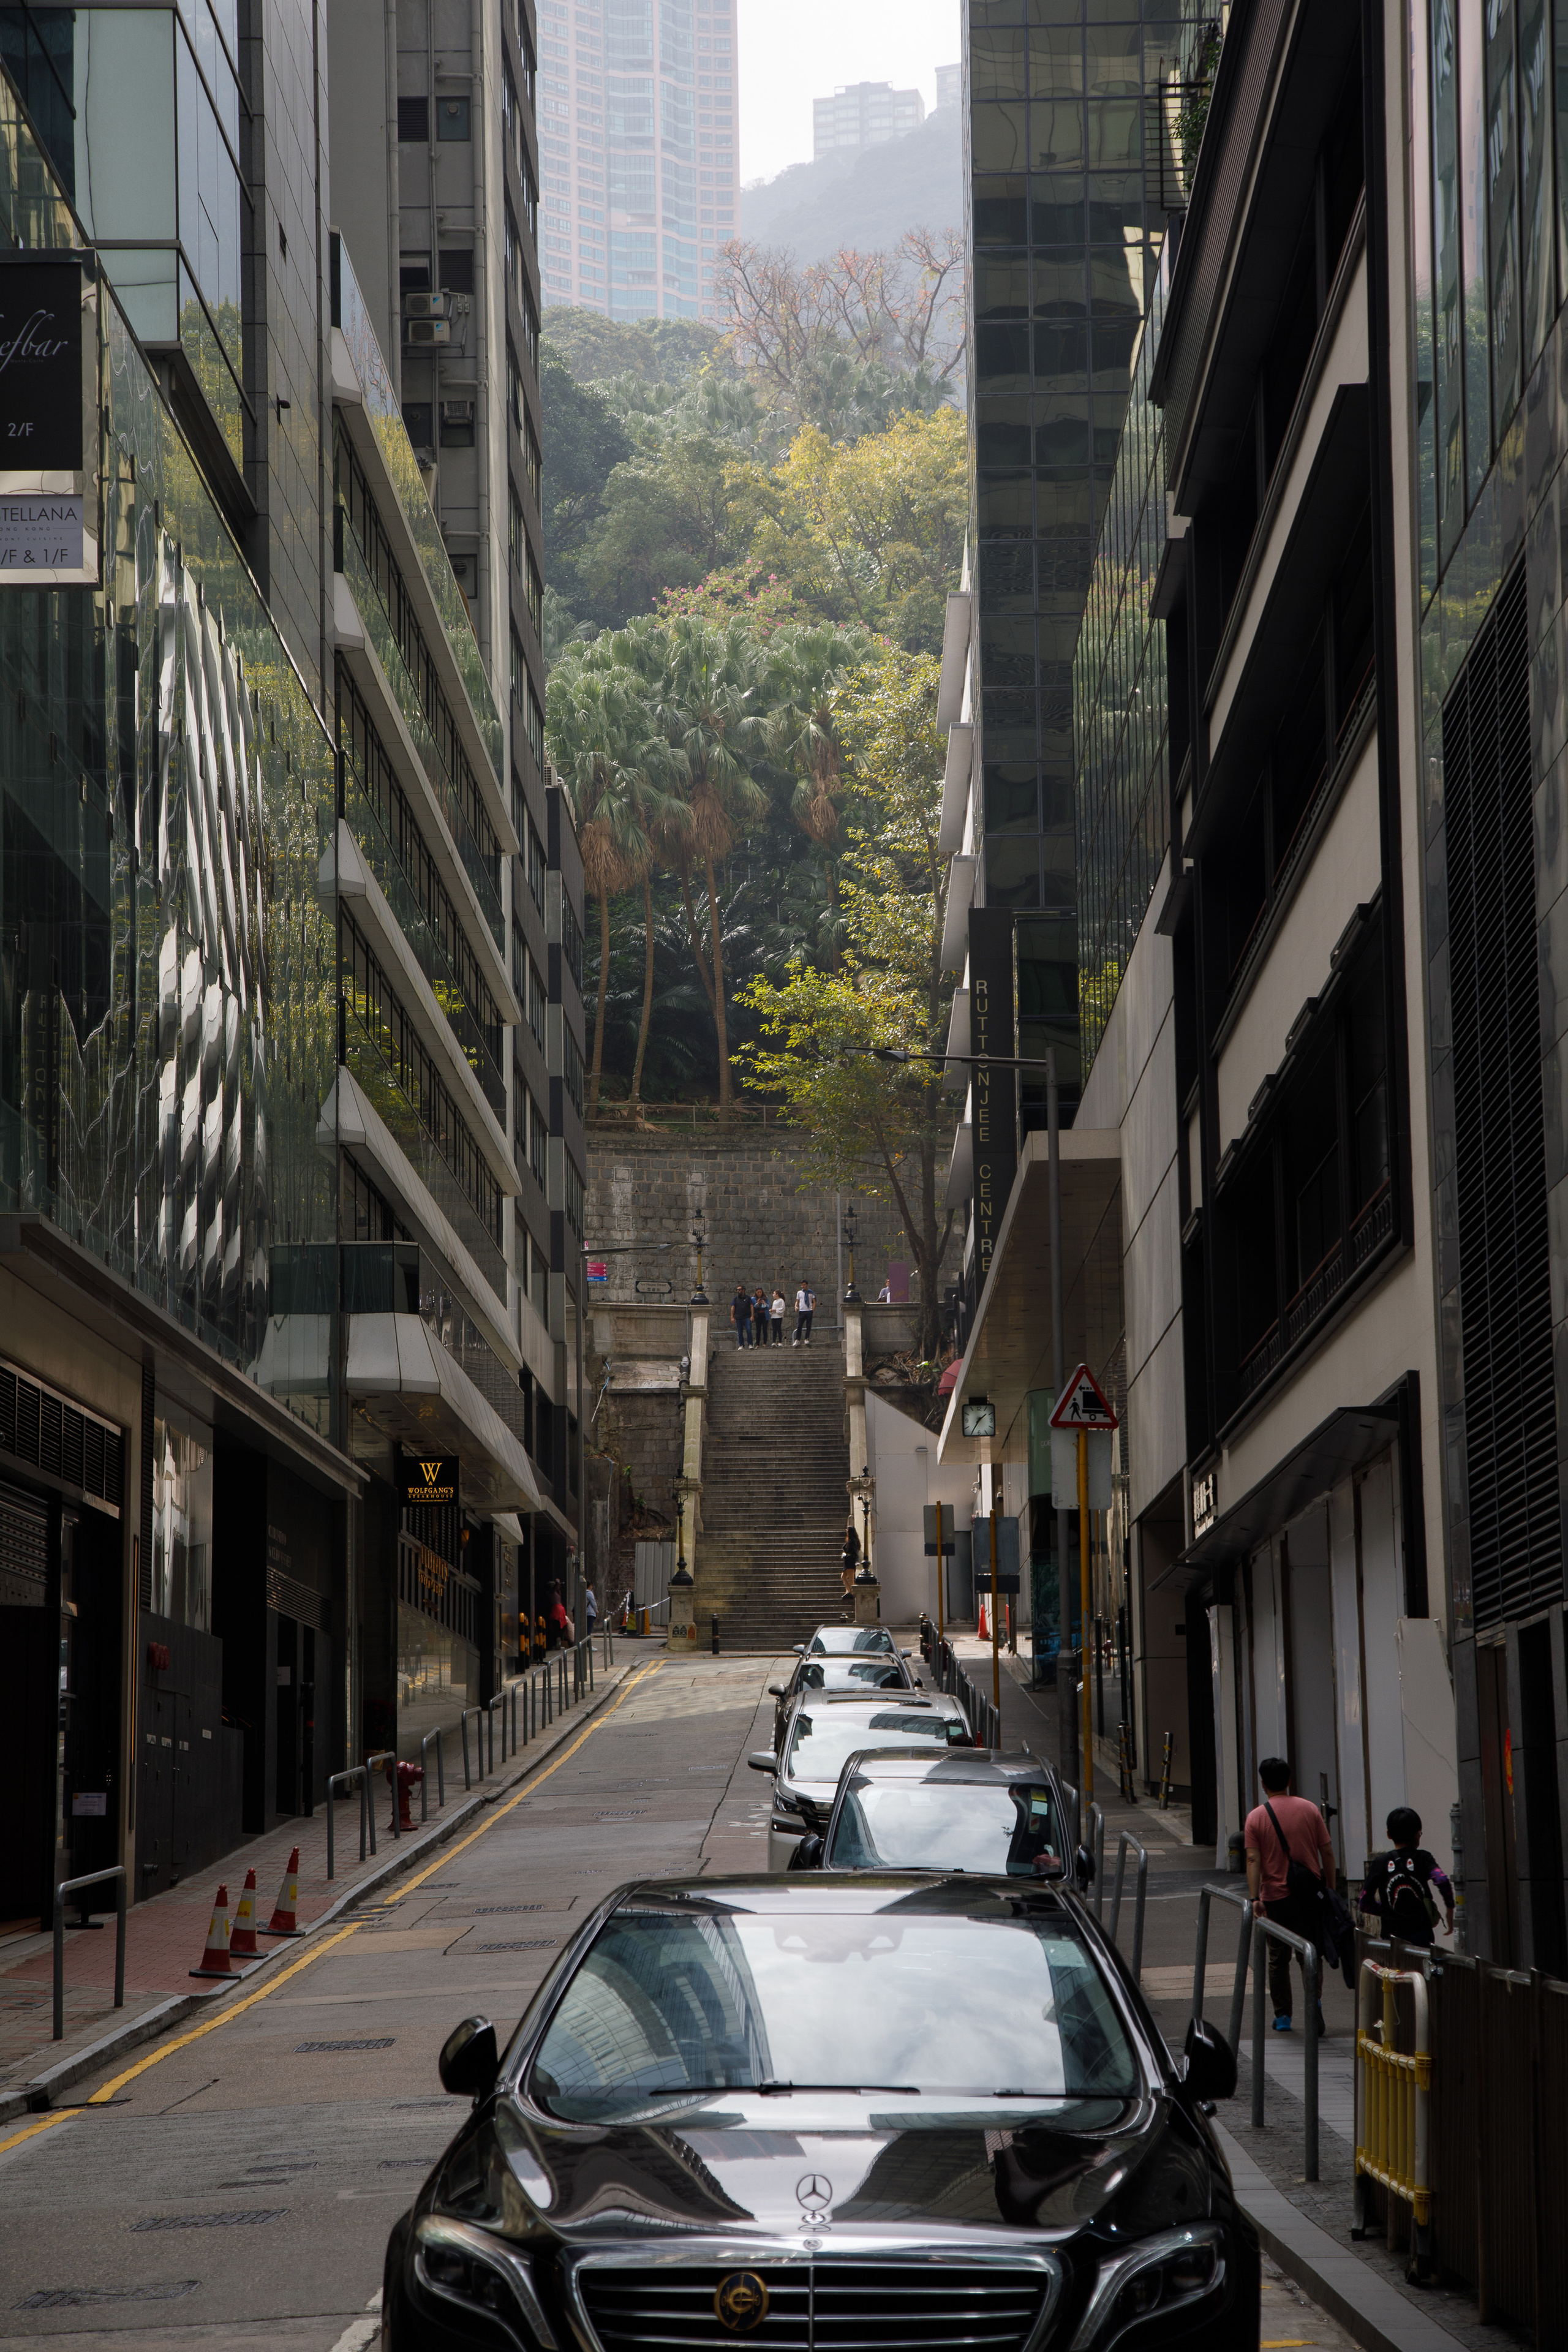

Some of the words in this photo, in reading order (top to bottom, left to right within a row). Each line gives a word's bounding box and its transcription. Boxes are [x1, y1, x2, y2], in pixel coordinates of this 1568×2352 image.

[8, 423, 33, 436] 2/F
[24, 550, 36, 563] &
[43, 549, 68, 564] 1/F
[976, 979, 990, 1142] RUTTONJEE
[979, 1164, 993, 1272] CENTRE
